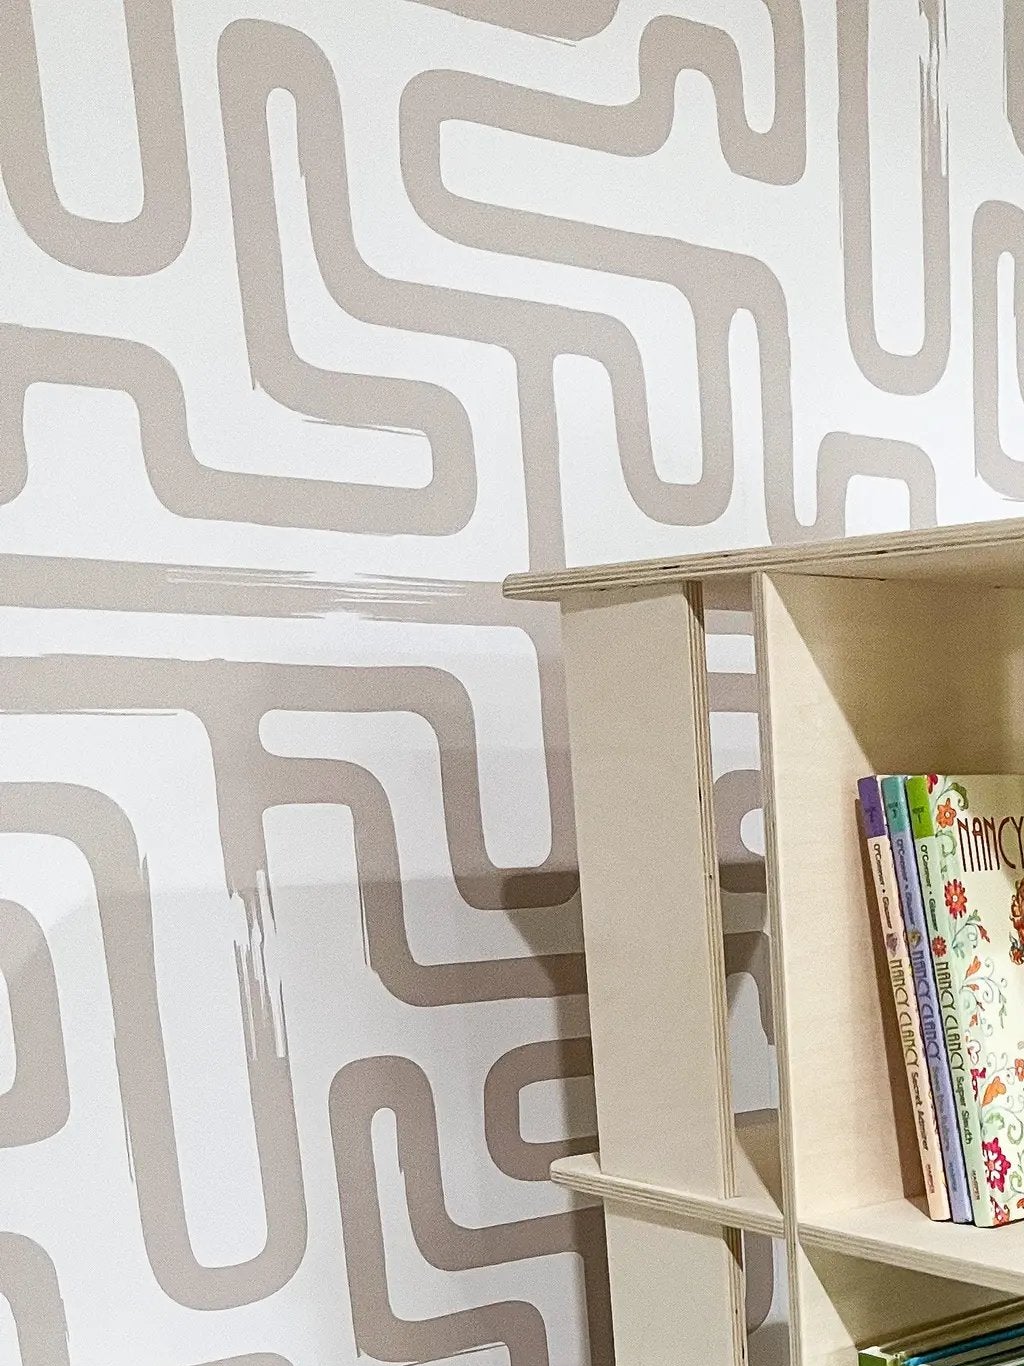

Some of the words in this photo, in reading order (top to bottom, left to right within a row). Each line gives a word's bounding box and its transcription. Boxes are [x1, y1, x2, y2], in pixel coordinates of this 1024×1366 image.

[957, 816, 1024, 872] NANCY
[889, 959, 910, 1007] NANCY
[912, 951, 931, 1000] NANCY
[935, 962, 956, 1010] NANCY
[899, 1012, 919, 1067] CLANCY
[921, 1003, 941, 1060] CLANCY
[944, 1015, 965, 1071] CLANCY
[955, 1076, 967, 1107] Super
